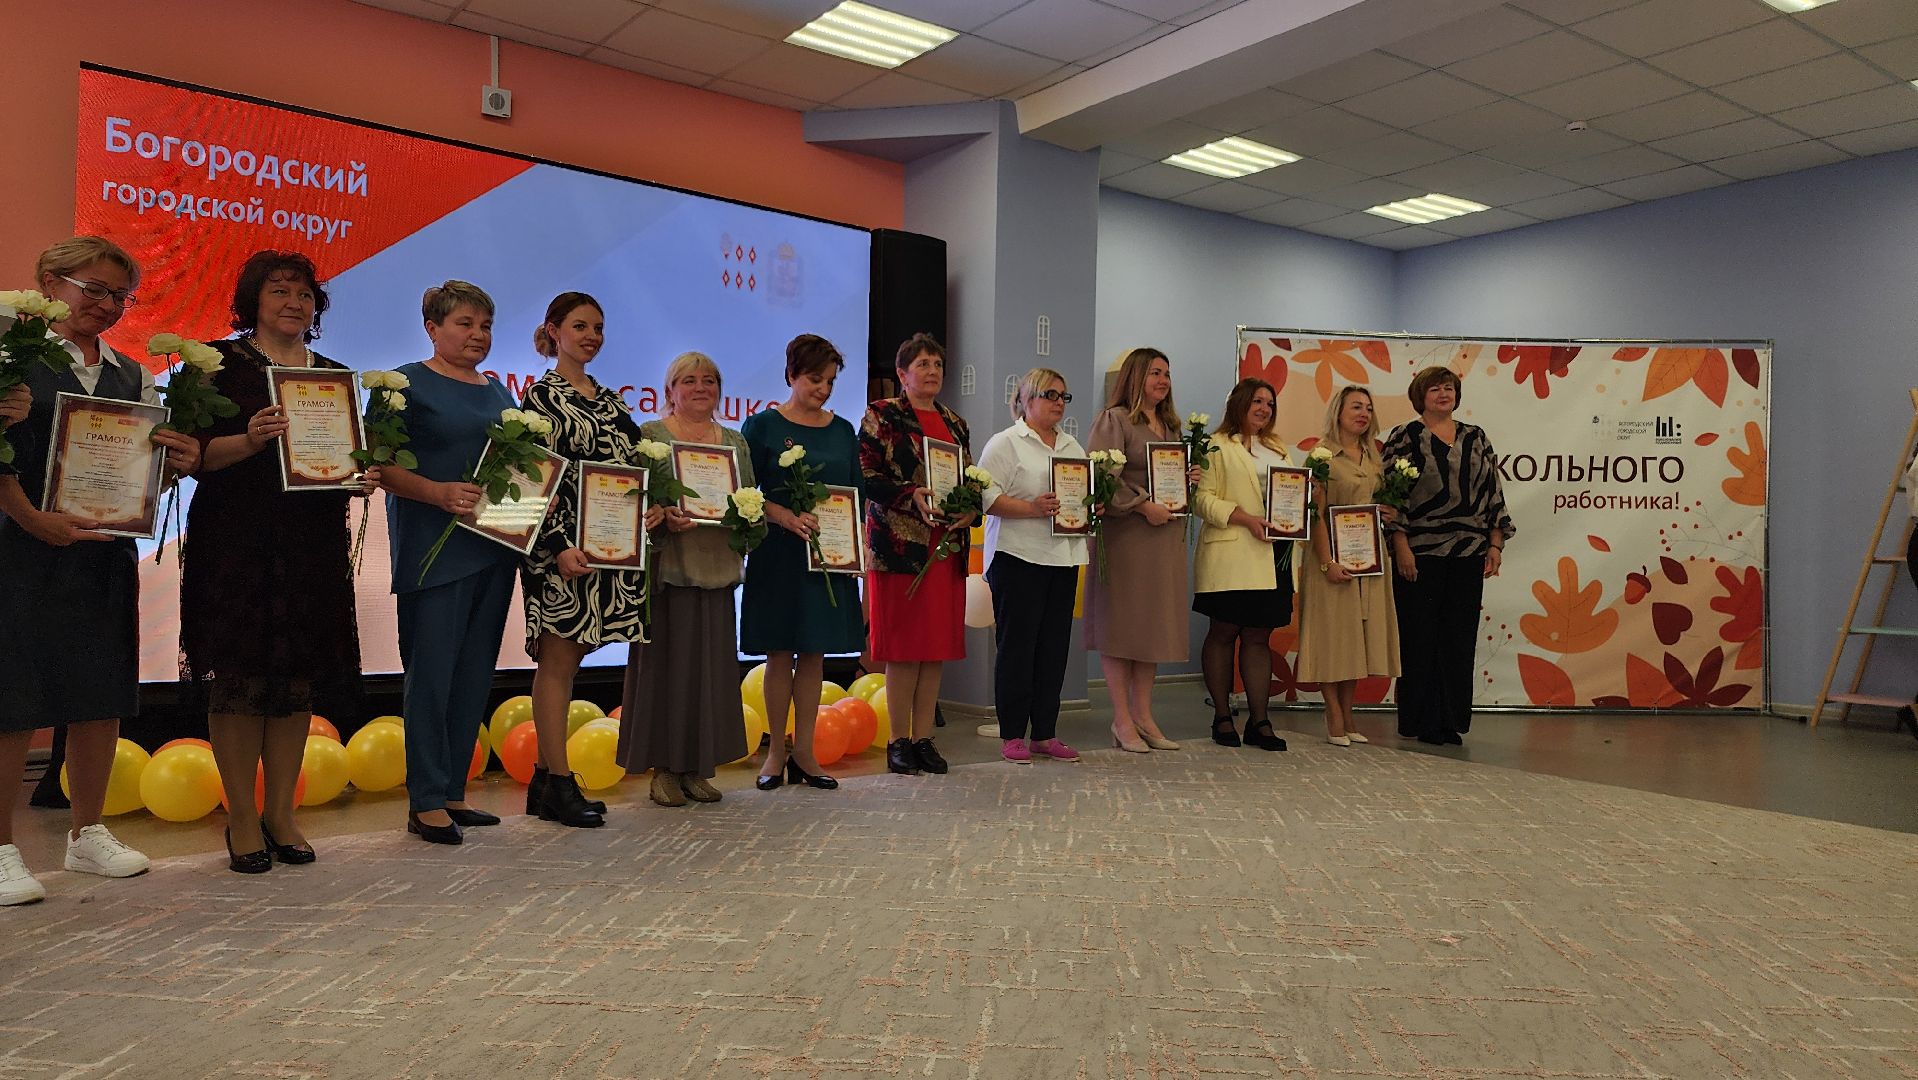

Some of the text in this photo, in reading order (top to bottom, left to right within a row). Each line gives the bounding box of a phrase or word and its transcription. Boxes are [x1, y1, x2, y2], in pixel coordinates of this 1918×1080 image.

[105, 116, 369, 198] Богородский
[102, 180, 353, 243] городской округ
[297, 400, 336, 408] ГРАМОТА
[85, 432, 134, 446] ГРАМОТА
[1553, 490, 1680, 514] работника!
